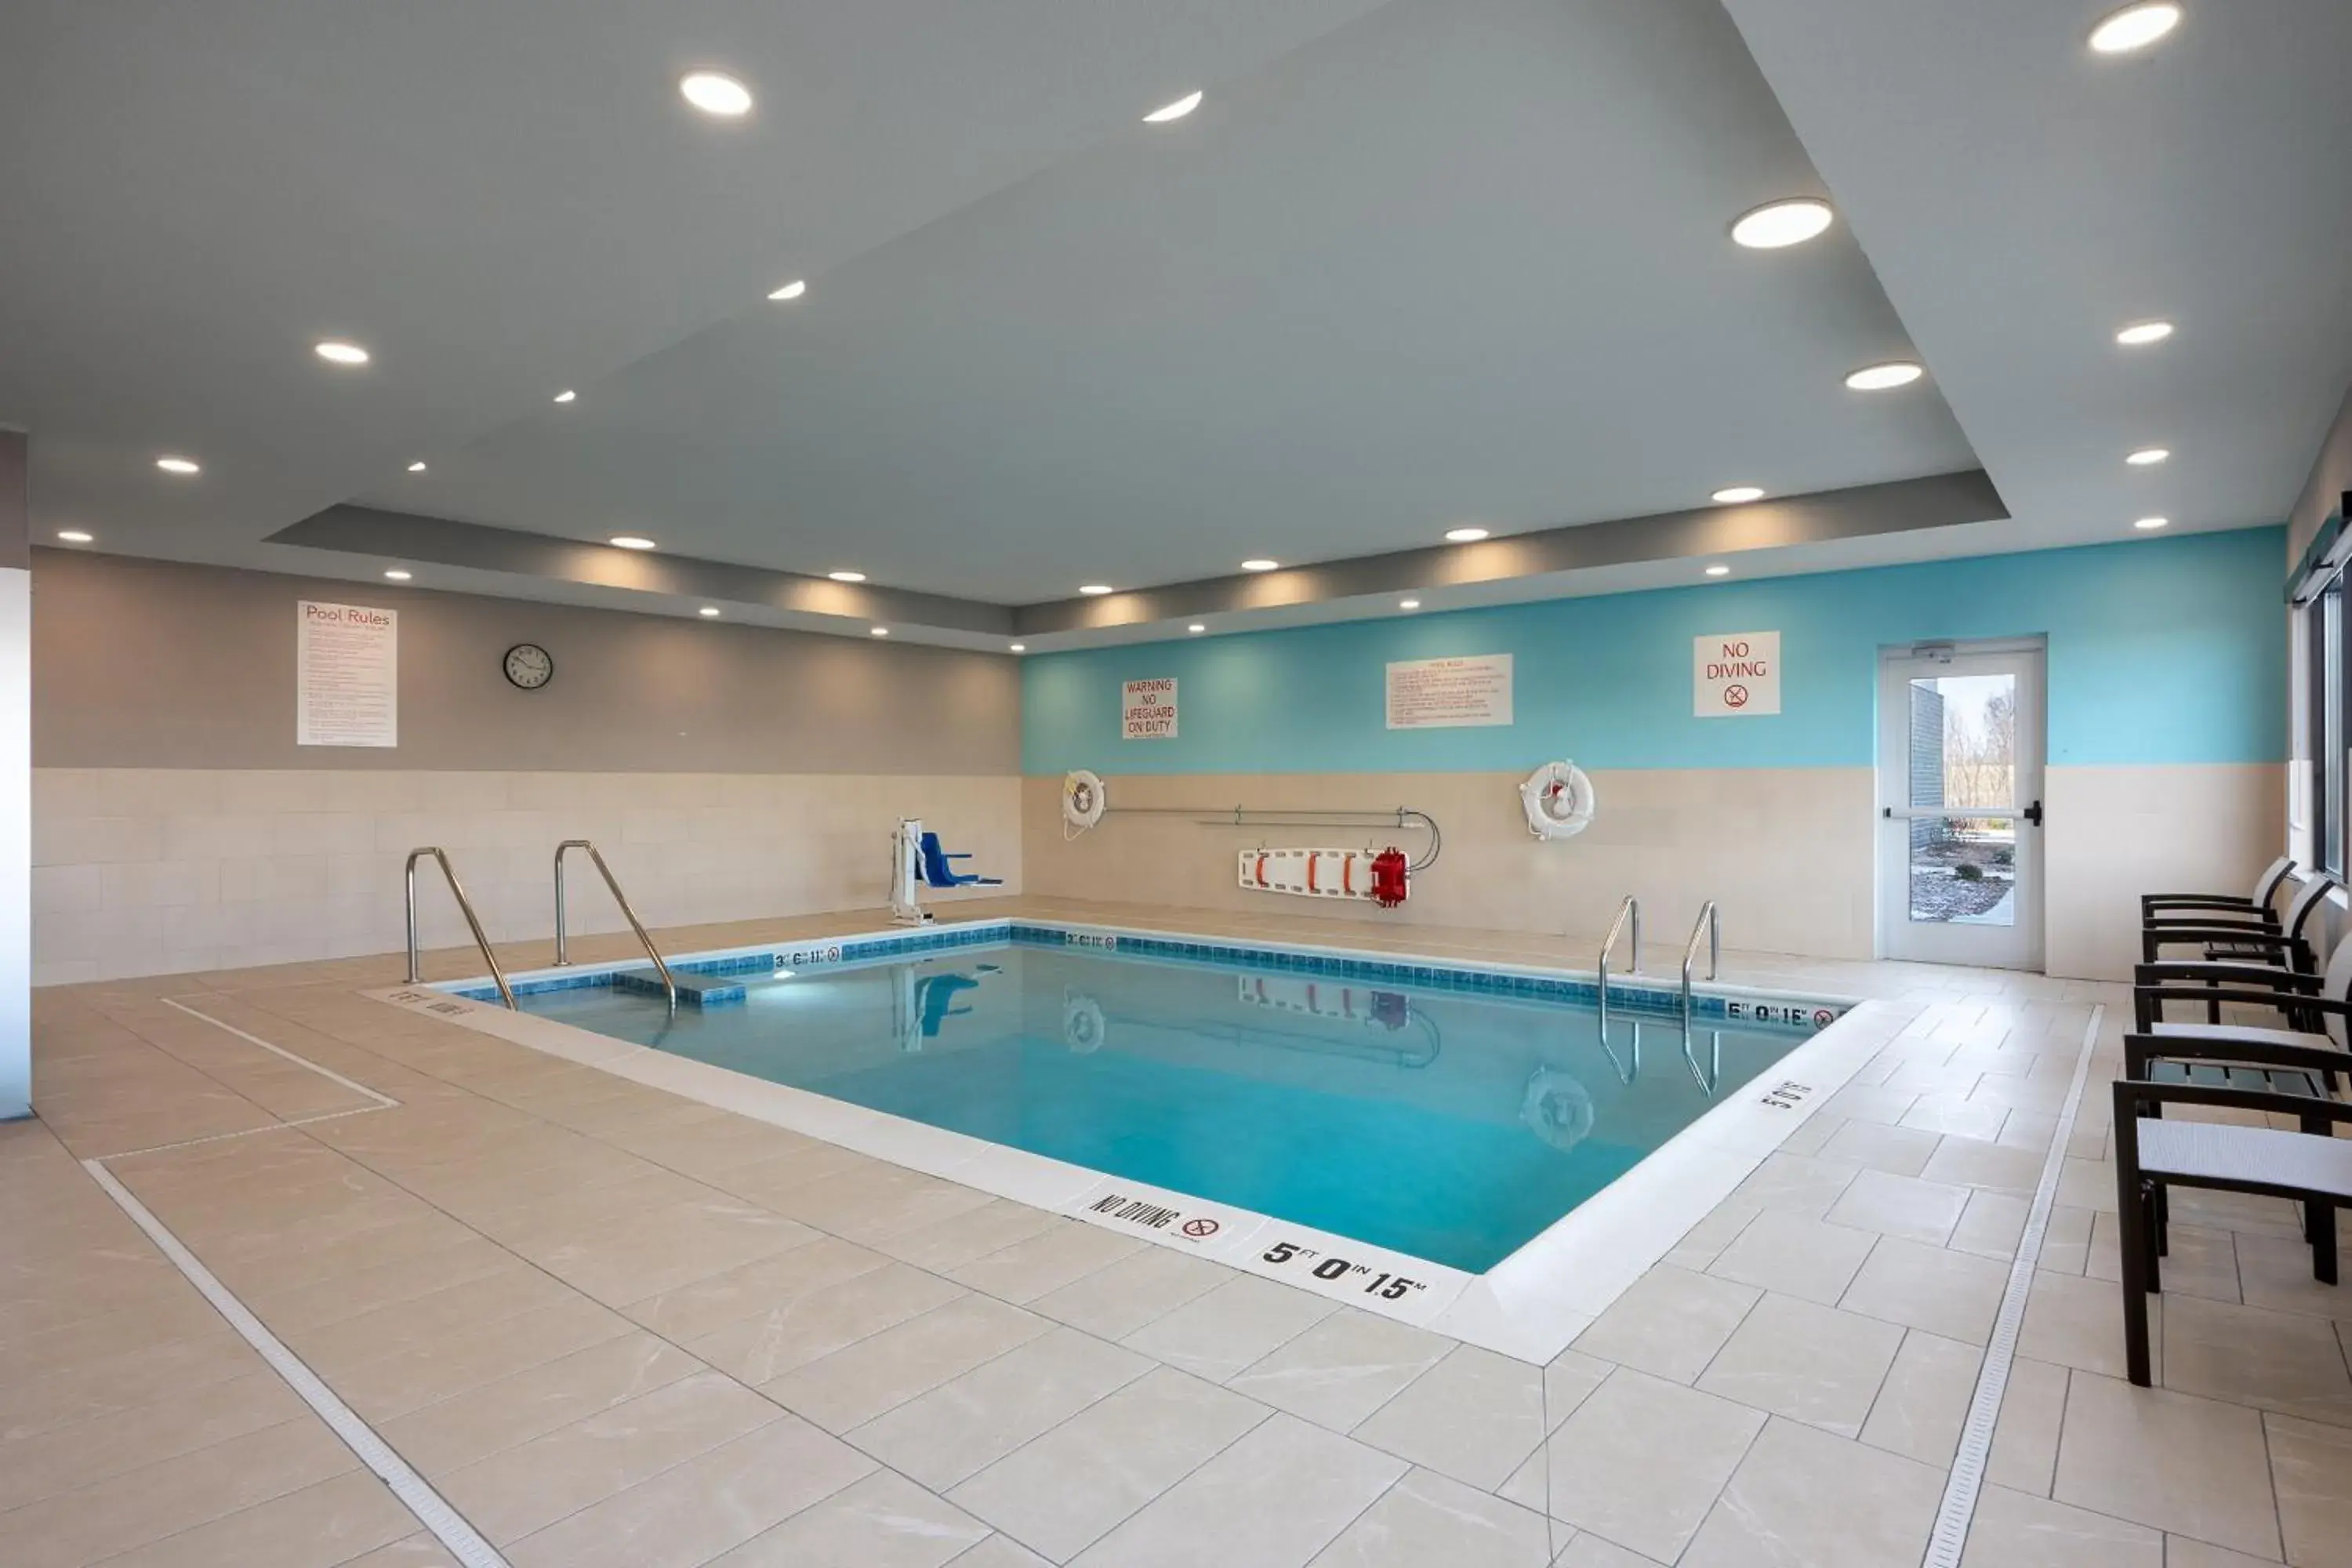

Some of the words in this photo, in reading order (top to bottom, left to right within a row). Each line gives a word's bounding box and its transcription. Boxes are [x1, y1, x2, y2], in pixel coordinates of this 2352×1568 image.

[307, 605, 342, 621] Pool
[349, 609, 390, 626] Rules
[1722, 641, 1750, 658] NO
[1707, 661, 1766, 680] DIVING
[1127, 679, 1172, 693] WARNING
[1142, 694, 1156, 705] NO
[1124, 706, 1174, 720] LIFEGUARD
[1128, 722, 1143, 733] ON
[1145, 720, 1171, 732] DUTY
[1088, 1194, 1127, 1213] NO
[1114, 1201, 1181, 1229] DIVING
